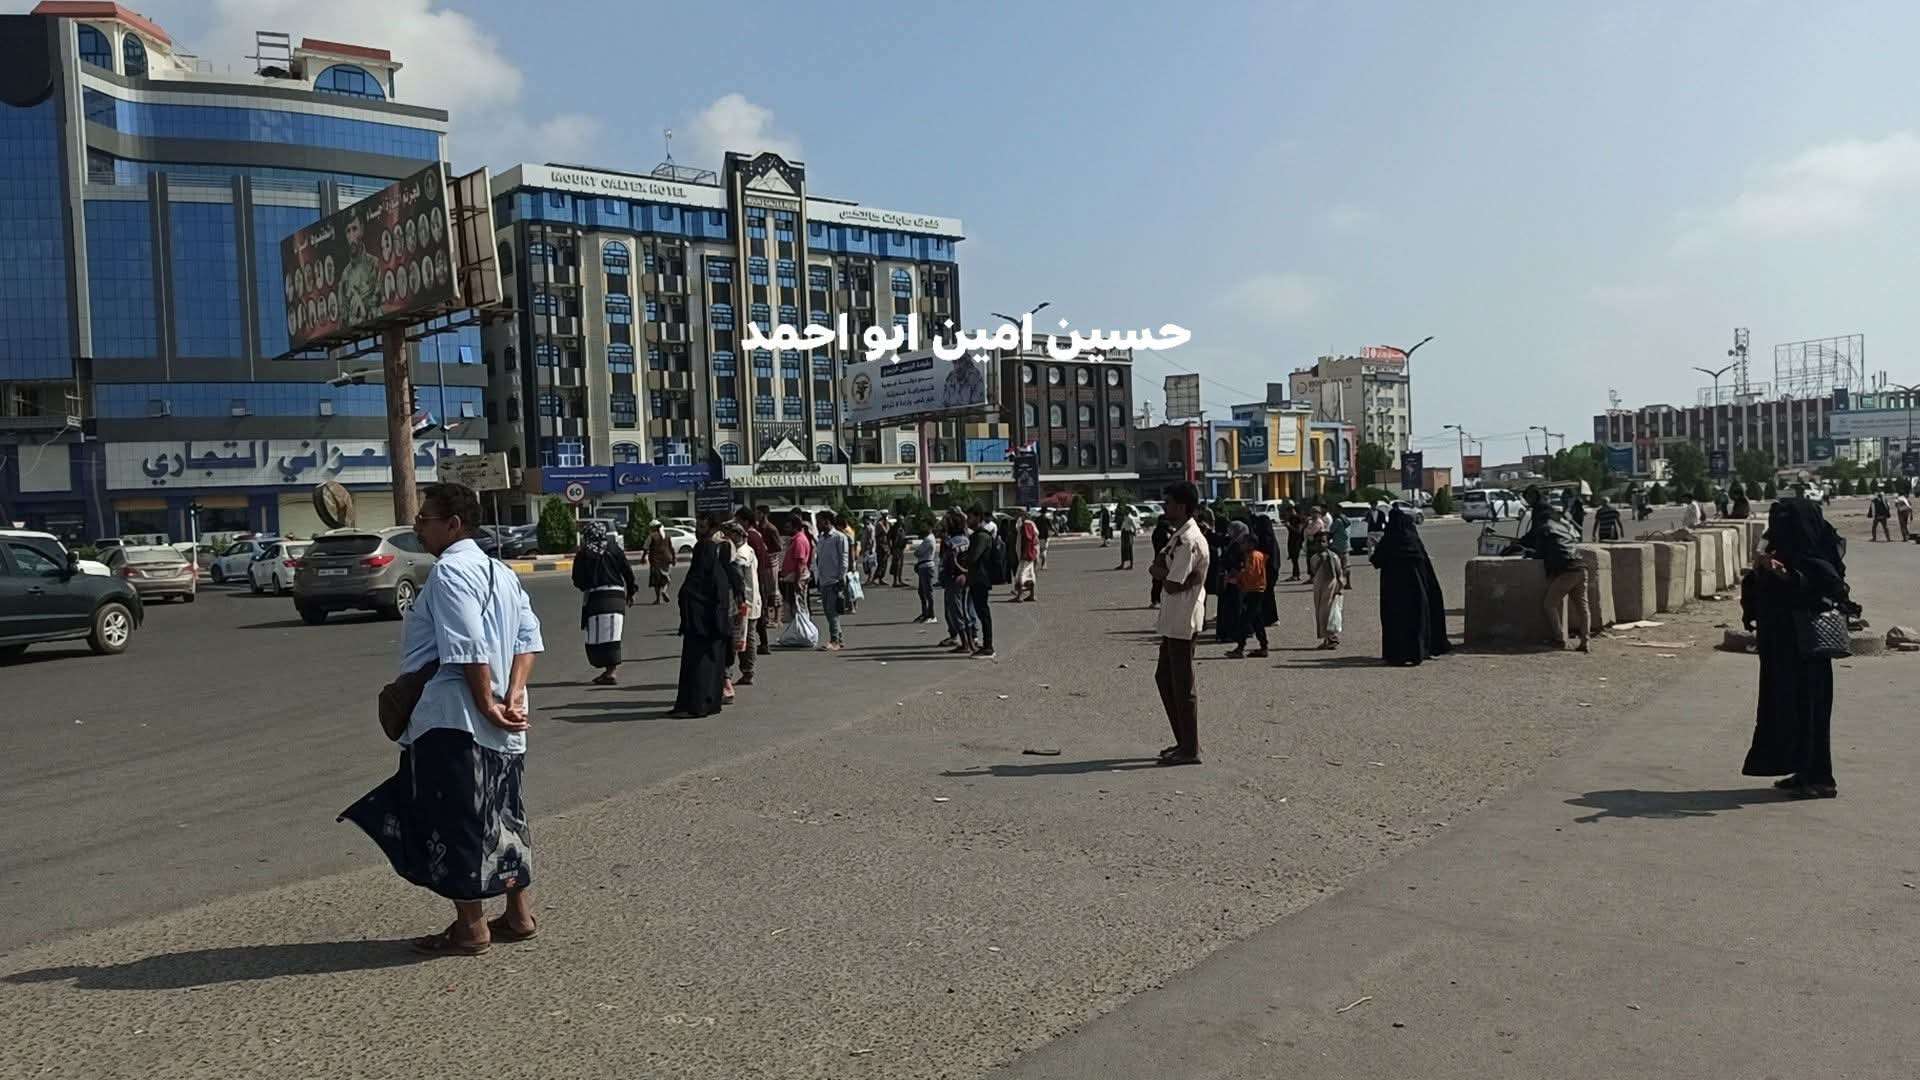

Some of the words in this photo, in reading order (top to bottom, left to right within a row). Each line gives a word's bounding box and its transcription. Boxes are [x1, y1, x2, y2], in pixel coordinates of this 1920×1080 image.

[551, 171, 599, 187] MOUNT
[649, 183, 688, 198] HOTEL
[142, 440, 270, 486] التجاري
[569, 487, 583, 498] 60
